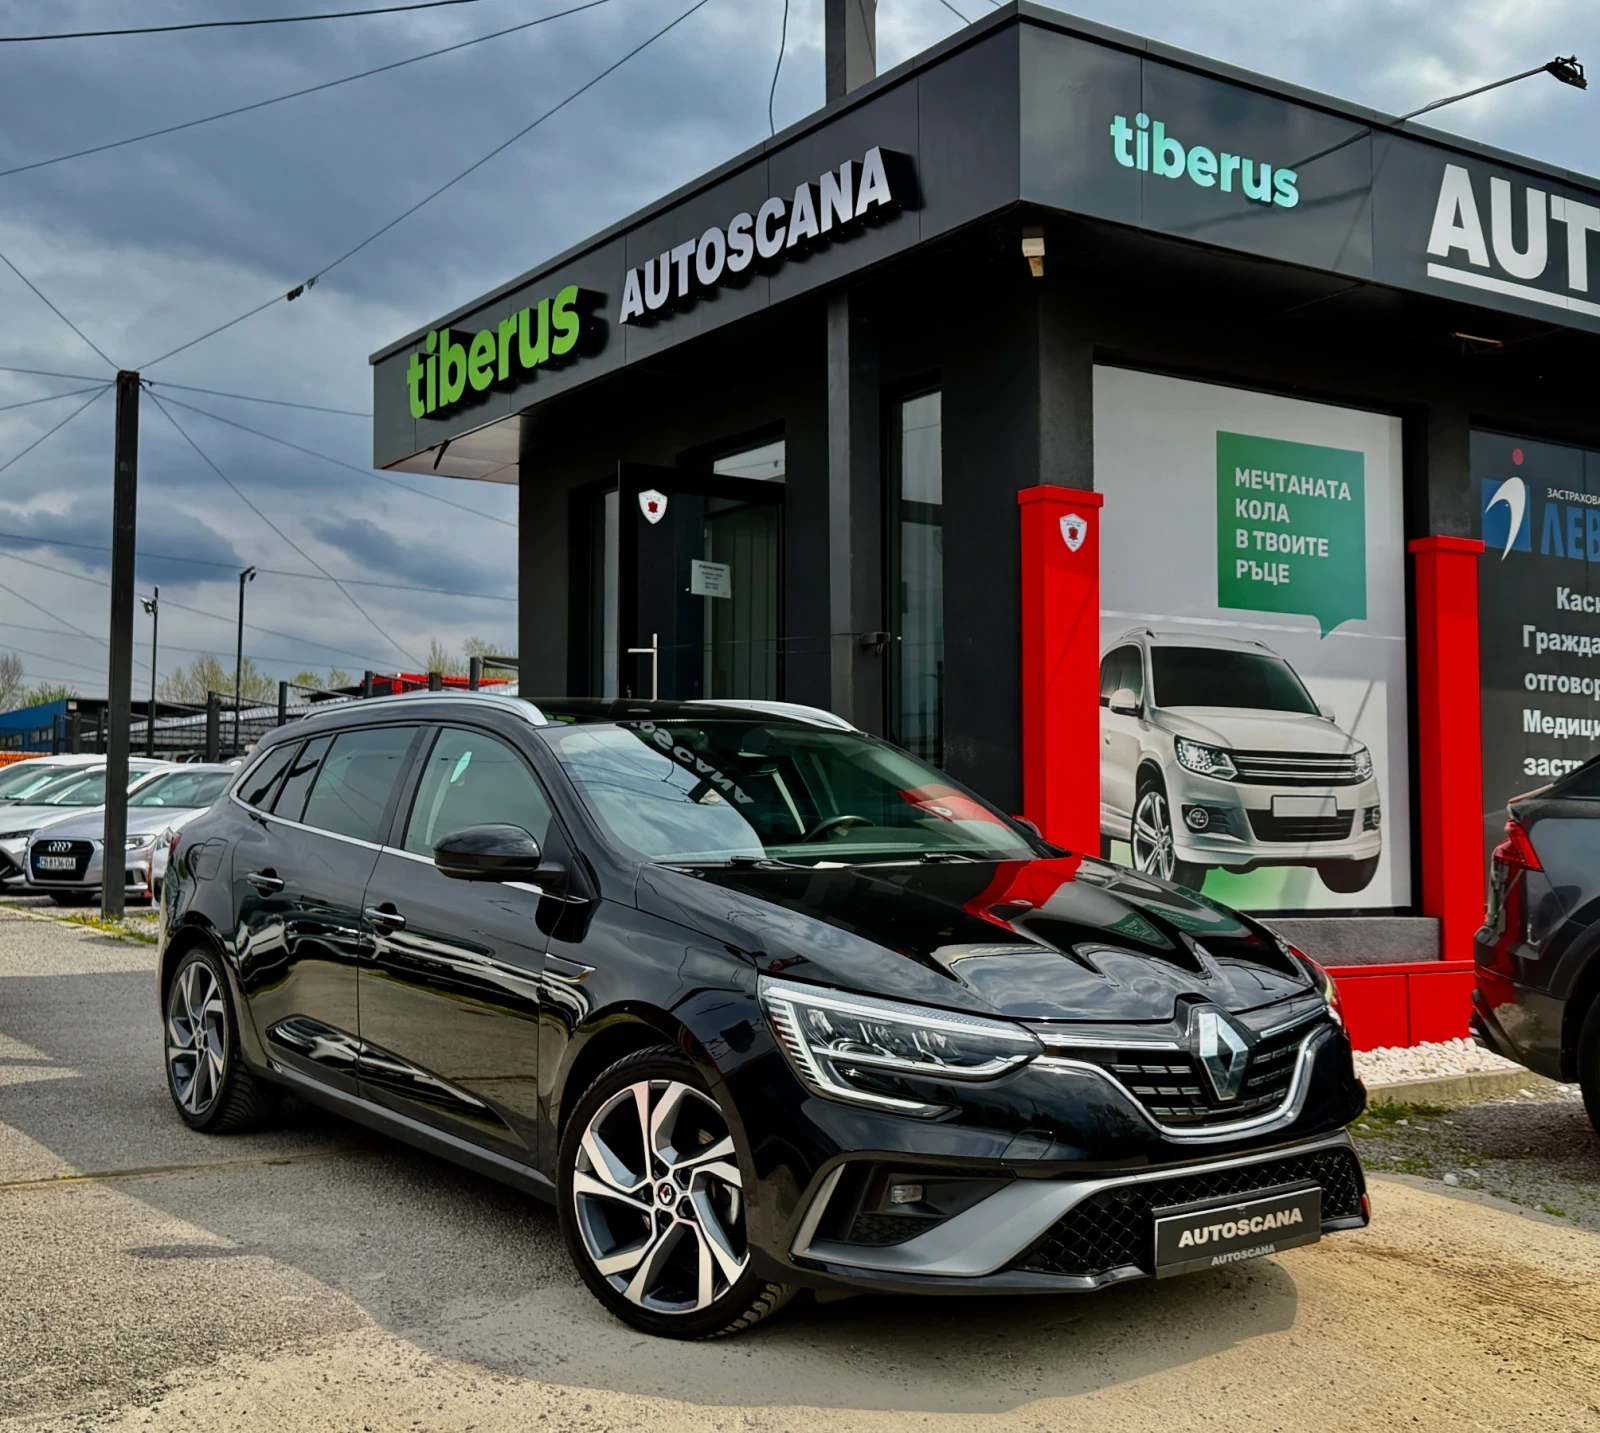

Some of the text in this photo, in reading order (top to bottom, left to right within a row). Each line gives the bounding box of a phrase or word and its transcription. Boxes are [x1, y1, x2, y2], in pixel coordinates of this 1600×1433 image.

[1110, 111, 1300, 209] tiberus
[619, 145, 892, 324] AUTOSCANA
[1426, 163, 1600, 293] AUT
[406, 284, 580, 420] tiberus
[1235, 467, 1352, 501] МЕЧТАНАТА
[1235, 498, 1290, 524] КОЛА
[1236, 528, 1329, 558] В ТВОИТЕ
[1236, 559, 1290, 586] РЪЦЕ
[1523, 624, 1600, 658] Гражда
[1178, 1207, 1303, 1248] AUTOSCANA
[1211, 1243, 1276, 1267] AUTOSCANA
